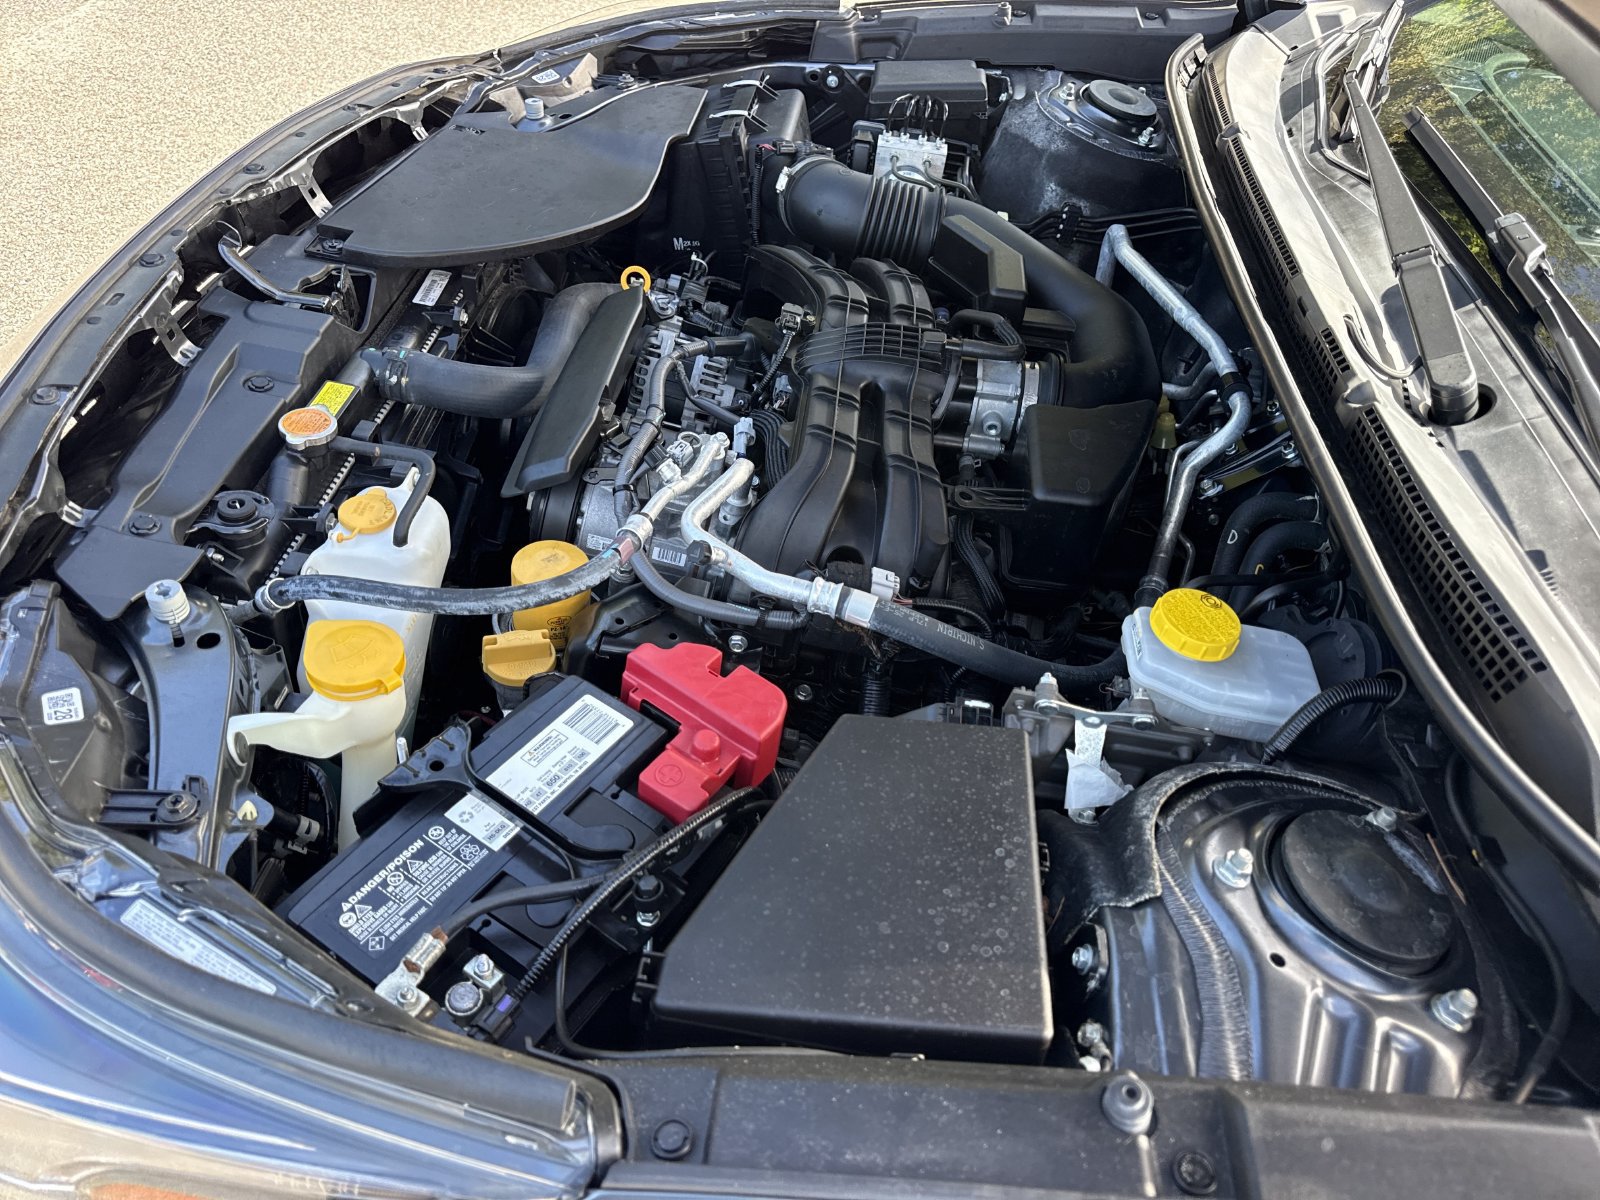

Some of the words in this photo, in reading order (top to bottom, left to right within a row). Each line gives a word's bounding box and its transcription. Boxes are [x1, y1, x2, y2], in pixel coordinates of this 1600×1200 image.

[1226, 529, 1238, 545] D
[54, 708, 74, 720] 28
[545, 774, 561, 787] 650
[347, 838, 424, 904] DANGER/POISON
[420, 884, 433, 895] READ
[430, 862, 459, 886] INSTRUCTIONS
